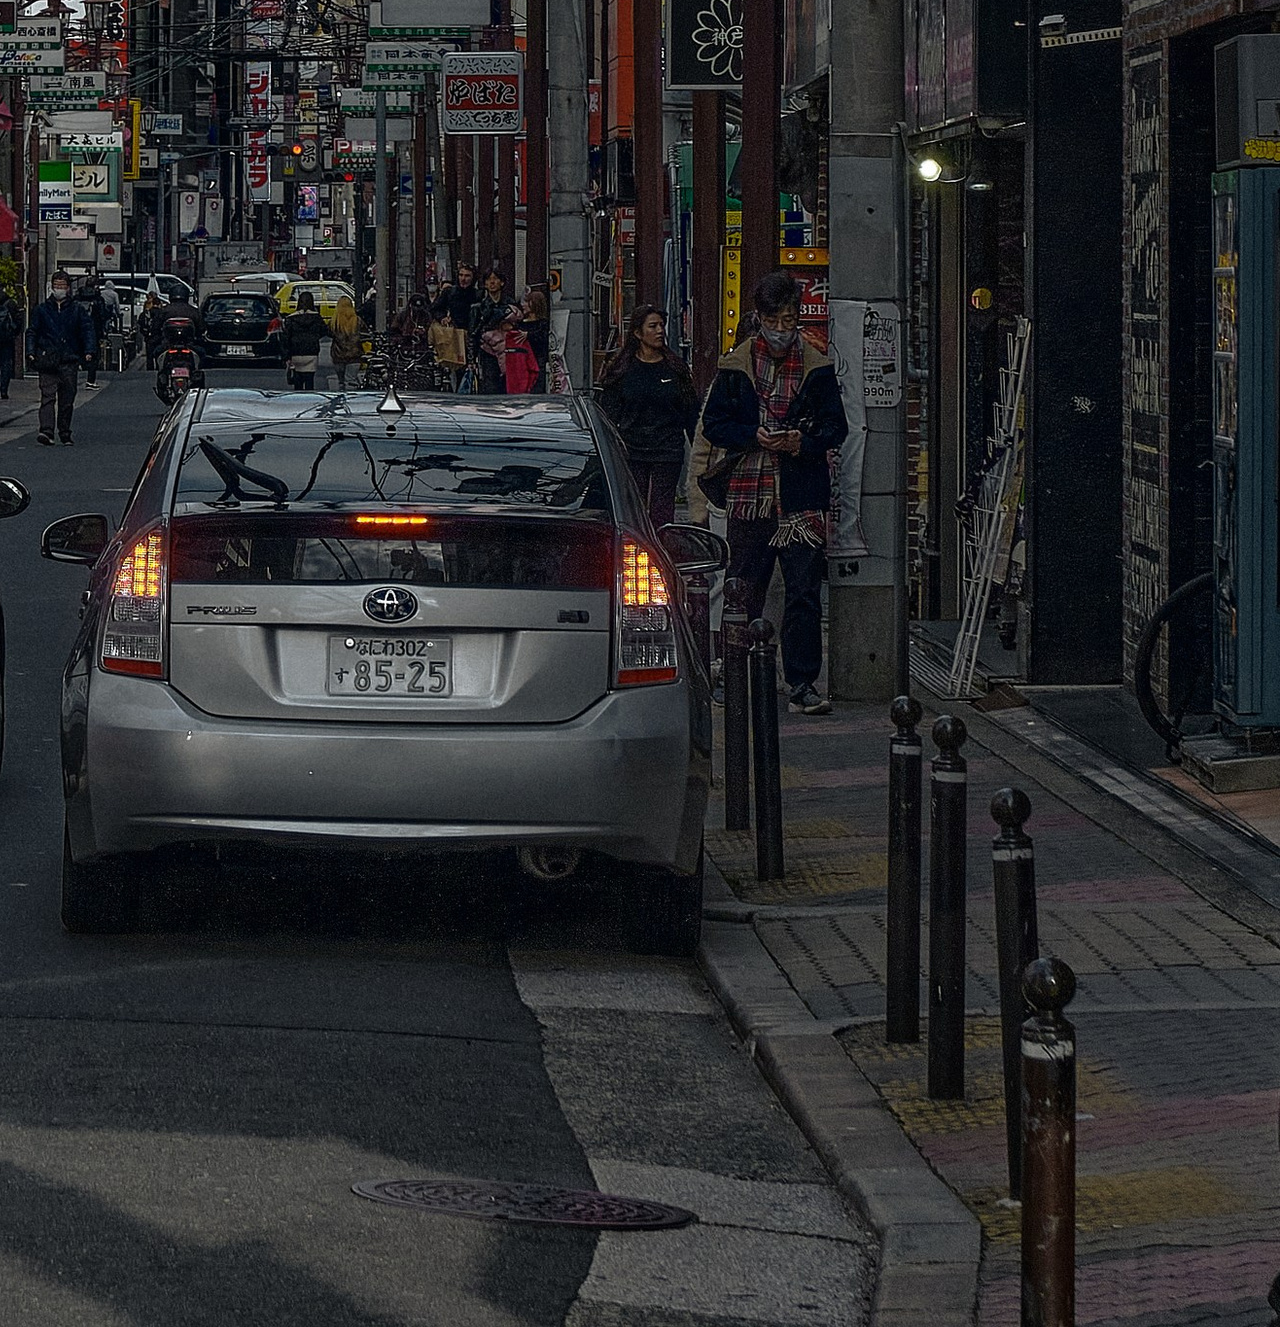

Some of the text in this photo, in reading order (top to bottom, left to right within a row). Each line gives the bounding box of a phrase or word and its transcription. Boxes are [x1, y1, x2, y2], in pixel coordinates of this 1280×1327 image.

[447, 78, 518, 106] 炉ばた
[45, 209, 69, 220] たばこ
[186, 604, 258, 616] PRIUS
[334, 660, 448, 694] す 85-25
